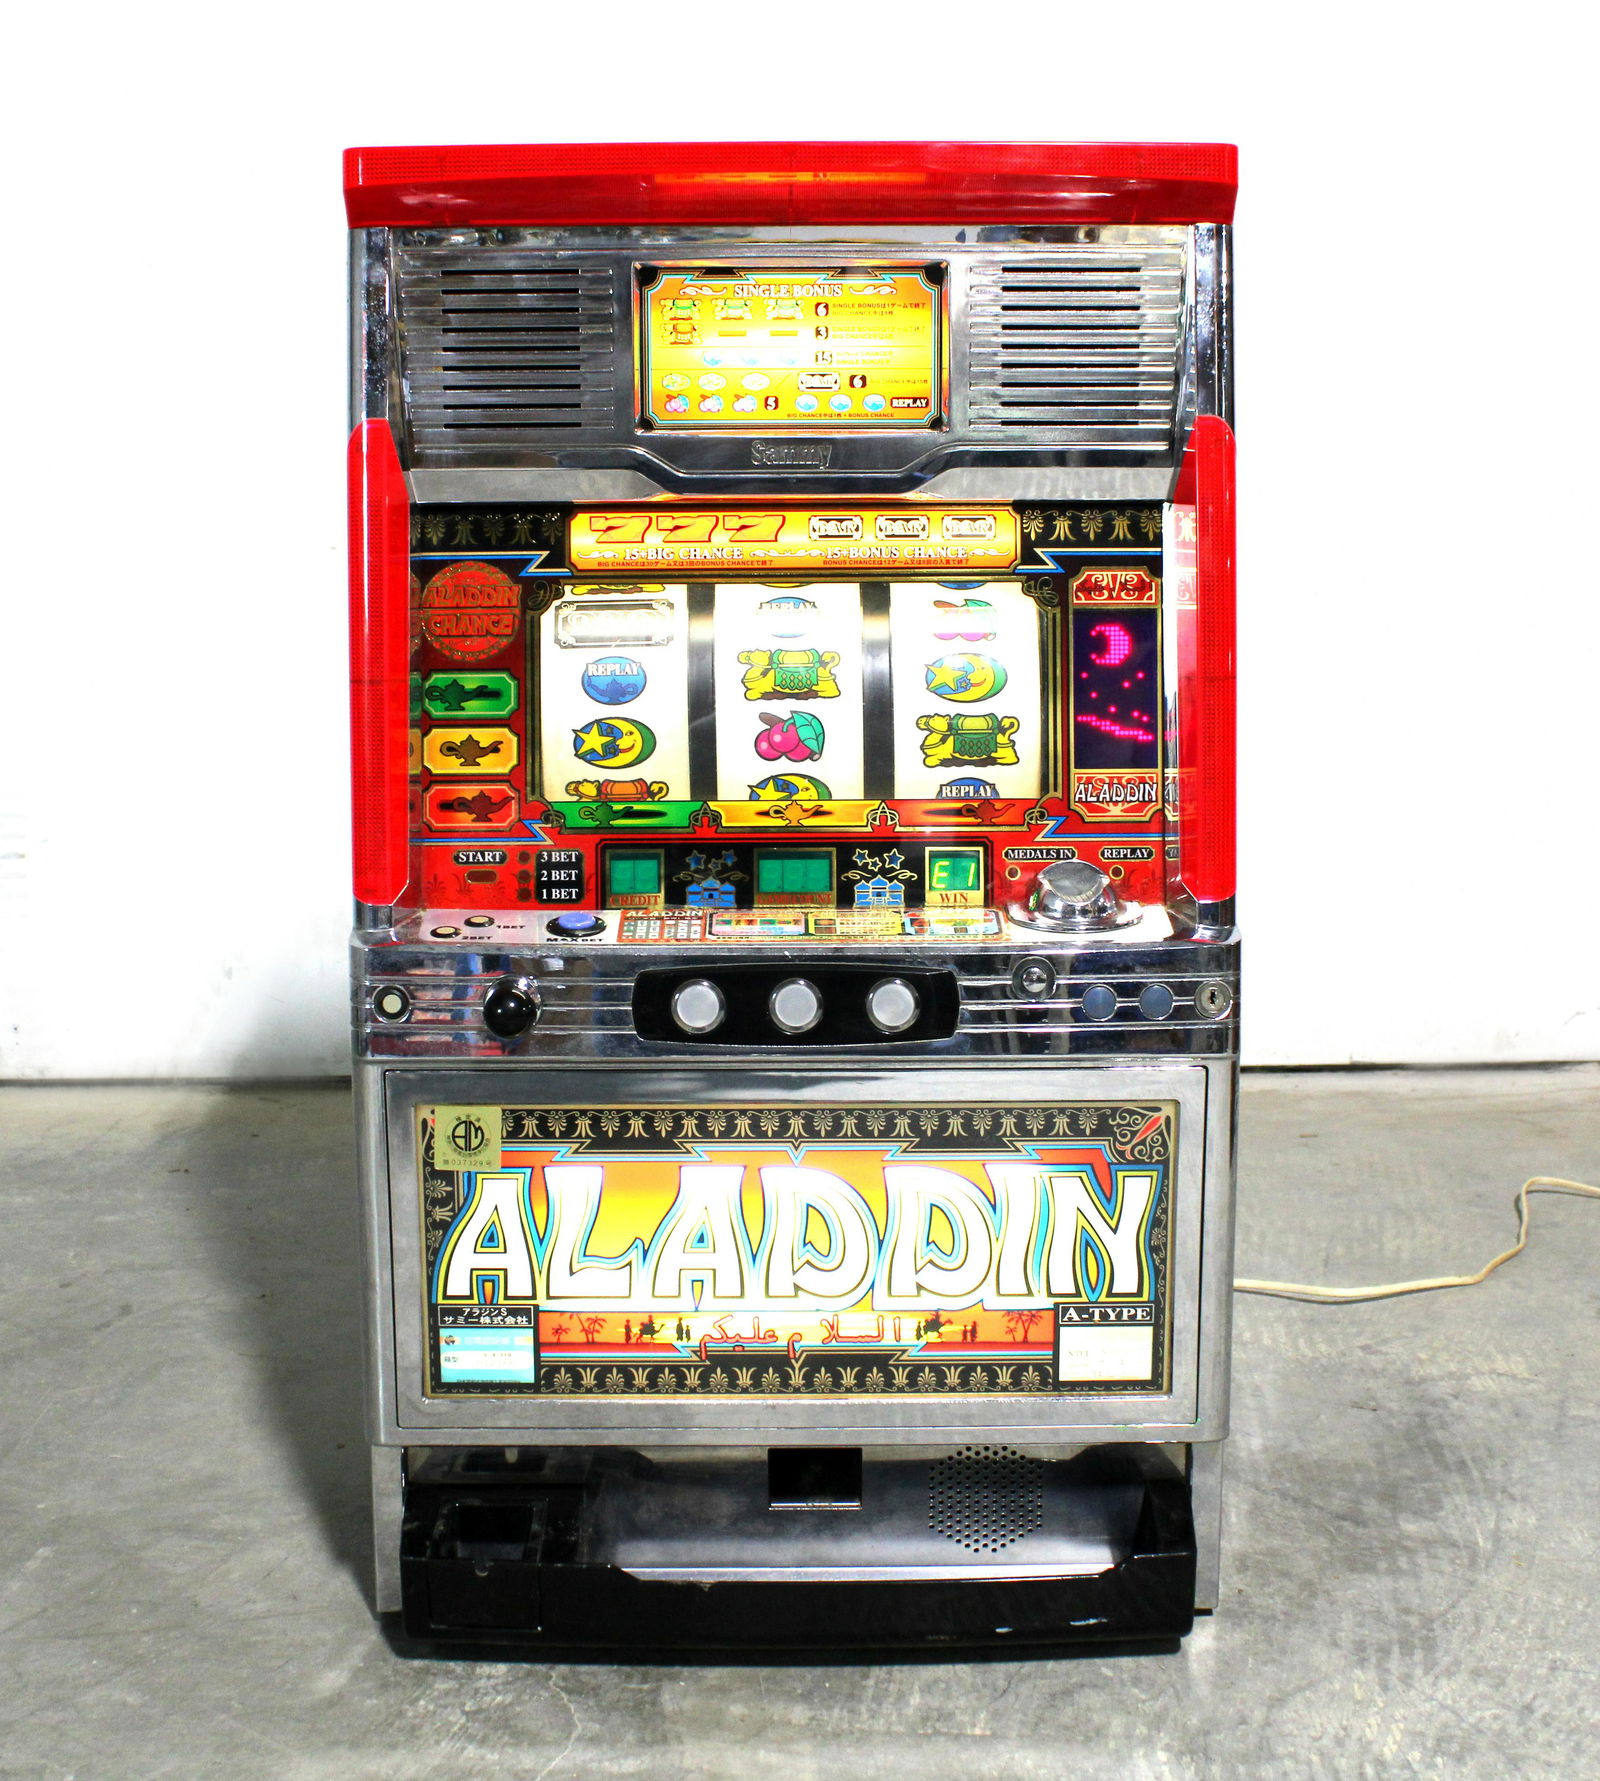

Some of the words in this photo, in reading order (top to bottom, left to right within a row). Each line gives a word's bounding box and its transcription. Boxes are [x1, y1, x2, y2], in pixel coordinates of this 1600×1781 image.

[734, 284, 790, 297] SINGLE
[792, 284, 843, 297] BONUS
[817, 303, 828, 316] 6
[816, 326, 828, 339] 3
[852, 375, 863, 388] 6
[766, 396, 776, 410] 5
[892, 398, 928, 407] REPLAY
[751, 440, 832, 470] Sammy
[817, 519, 857, 535] BAR
[884, 519, 924, 535] BAR
[624, 548, 674, 560] 15+BIG
[679, 547, 743, 559] CHANCE
[826, 546, 900, 559] 15+BONUS
[903, 546, 968, 558] CHANCE
[426, 585, 520, 608] ALADDIN
[428, 614, 514, 636] CHANCE
[587, 663, 641, 676] REPLAY
[941, 784, 995, 798] REPLAY
[1075, 783, 1157, 802] ALADDIN
[458, 851, 502, 862] START
[541, 852, 548, 862] 3
[551, 852, 578, 862] BET
[1008, 850, 1057, 859] MEDALS
[1059, 850, 1072, 858] IN
[1104, 849, 1150, 858] REPLAY
[541, 870, 548, 881] 2
[551, 870, 578, 881] BET
[542, 889, 547, 899] 1
[551, 889, 578, 899] BET
[609, 895, 660, 906] CREDIT
[940, 893, 968, 903] WIN
[437, 1164, 1160, 1306] ALADDIN
[443, 1316, 529, 1325] サミー株式会社
[1063, 1307, 1151, 1321] A-TYPE
